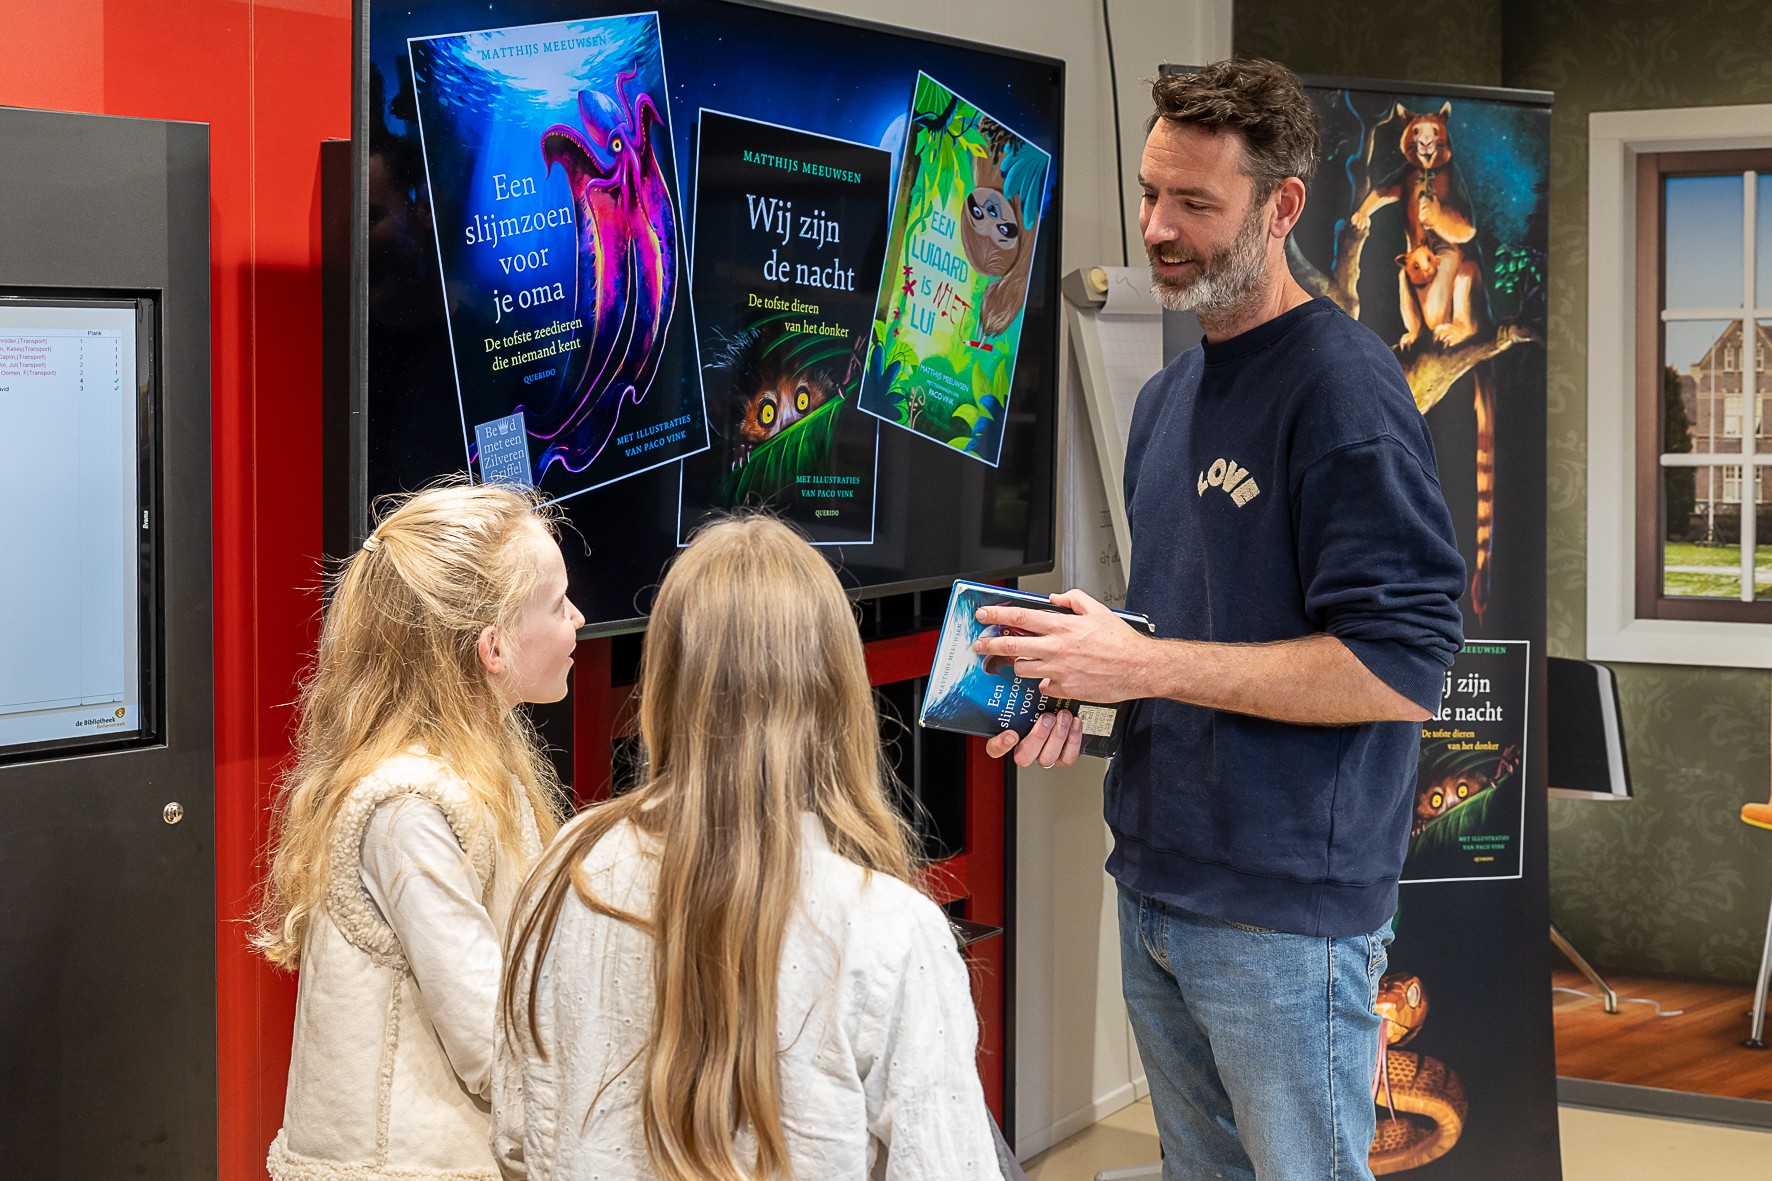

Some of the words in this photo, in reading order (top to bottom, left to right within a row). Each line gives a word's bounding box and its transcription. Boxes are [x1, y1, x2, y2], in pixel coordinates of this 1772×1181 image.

[481, 43, 539, 60] MATTHIJS
[543, 36, 608, 53] MEEUWSEN
[743, 150, 799, 173] MATTHIJS
[802, 162, 862, 184] MEEUWSEN
[493, 173, 537, 201] Een
[465, 205, 573, 248] slijmzoen
[746, 193, 792, 246] Wij
[799, 209, 840, 250] zijn
[930, 210, 956, 240] EEN
[499, 247, 549, 275] voor
[763, 248, 790, 282] de
[795, 258, 855, 291] nacht
[493, 289, 514, 324] je
[518, 281, 565, 309] oma
[748, 293, 762, 307] De
[764, 296, 789, 311] tofste
[791, 298, 819, 315] dieren
[484, 338, 501, 353] De
[503, 330, 533, 348] tofste
[534, 318, 583, 340] zeedieren
[785, 321, 801, 332] van
[803, 319, 817, 334] het
[819, 322, 849, 338] donker
[492, 356, 510, 371] die
[511, 341, 557, 367] niemand
[558, 338, 581, 353] kent
[523, 368, 556, 385] QUERIDO
[920, 364, 942, 380] MATTHIJS
[942, 374, 969, 392] MEEUWSEN
[928, 388, 943, 400] PACO
[617, 433, 634, 446] MET
[636, 414, 691, 439] ILLUSTRATIES
[484, 438, 504, 454] met
[504, 435, 522, 448] een
[625, 445, 642, 458] VAN
[644, 437, 665, 452] PACO
[666, 430, 686, 444] VINK
[484, 449, 525, 470] Zilveren
[490, 461, 522, 481] Griffel
[796, 475, 811, 484] MET
[813, 476, 860, 485] ILLUSTRATIES
[1197, 458, 1260, 508] LOVE
[801, 489, 816, 498] VAN
[817, 489, 836, 498] PACO
[837, 490, 854, 498] VINK
[815, 509, 840, 518] QUERIDO
[987, 684, 1005, 708] Een
[1457, 673, 1491, 698] zijn
[998, 674, 1022, 728] slijmzoe
[1020, 687, 1035, 715] voor
[1455, 701, 1503, 721] nacht
[84, 717, 116, 726] Bibliotheek
[1422, 730, 1432, 738] De
[1447, 742, 1461, 750] van
[1462, 741, 1473, 750] het
[1474, 741, 1499, 750] donker
